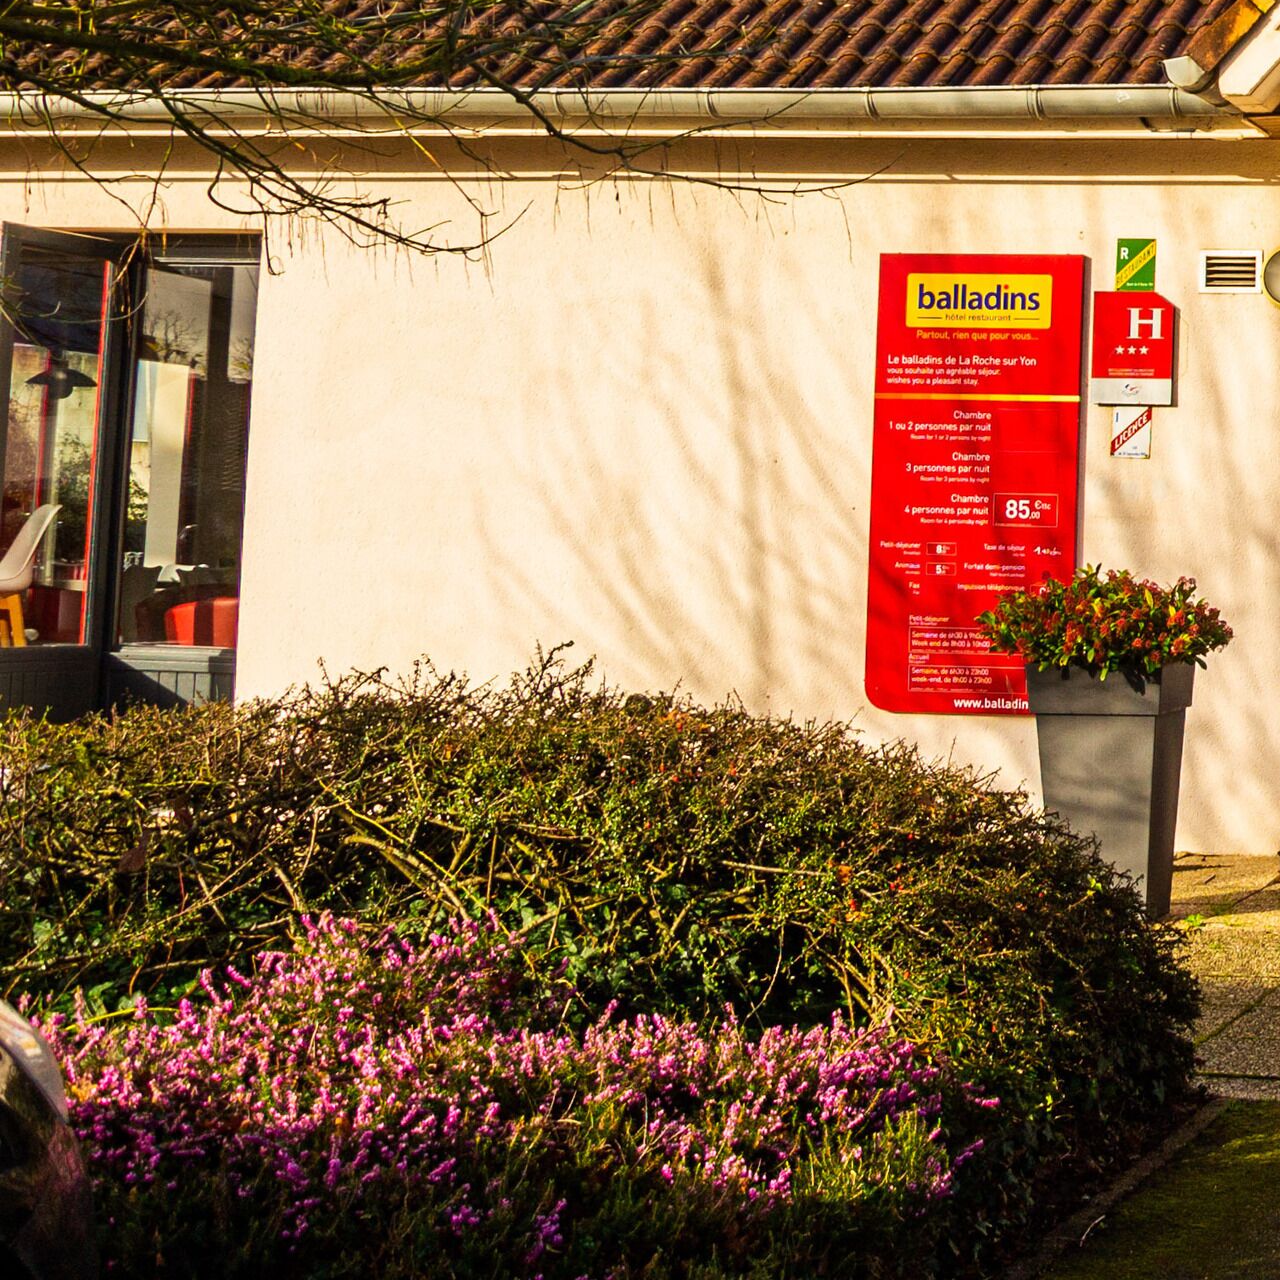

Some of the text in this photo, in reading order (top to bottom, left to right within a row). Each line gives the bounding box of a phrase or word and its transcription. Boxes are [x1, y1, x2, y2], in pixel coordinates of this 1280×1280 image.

[1120, 247, 1129, 260] R
[918, 283, 1040, 311] balladins
[1126, 307, 1165, 340] H
[916, 329, 1039, 343] Partout, rien que pour vous...
[887, 354, 1037, 366] Le balladins de La Roche sur Yon
[904, 366, 934, 375] souhaite
[945, 367, 977, 376] agréable
[886, 376, 911, 385] wishes
[912, 378, 925, 387] you
[931, 377, 962, 387] pleasant
[953, 410, 992, 420] Chambre
[889, 421, 992, 433] 1 ou 2 personnes par nuit
[1114, 411, 1149, 449] LICENCE
[952, 451, 991, 462] Chambre
[905, 462, 990, 474] 3 personnes par nuit
[951, 493, 990, 503] Chambre
[904, 504, 989, 517] 4 personnes par nuit
